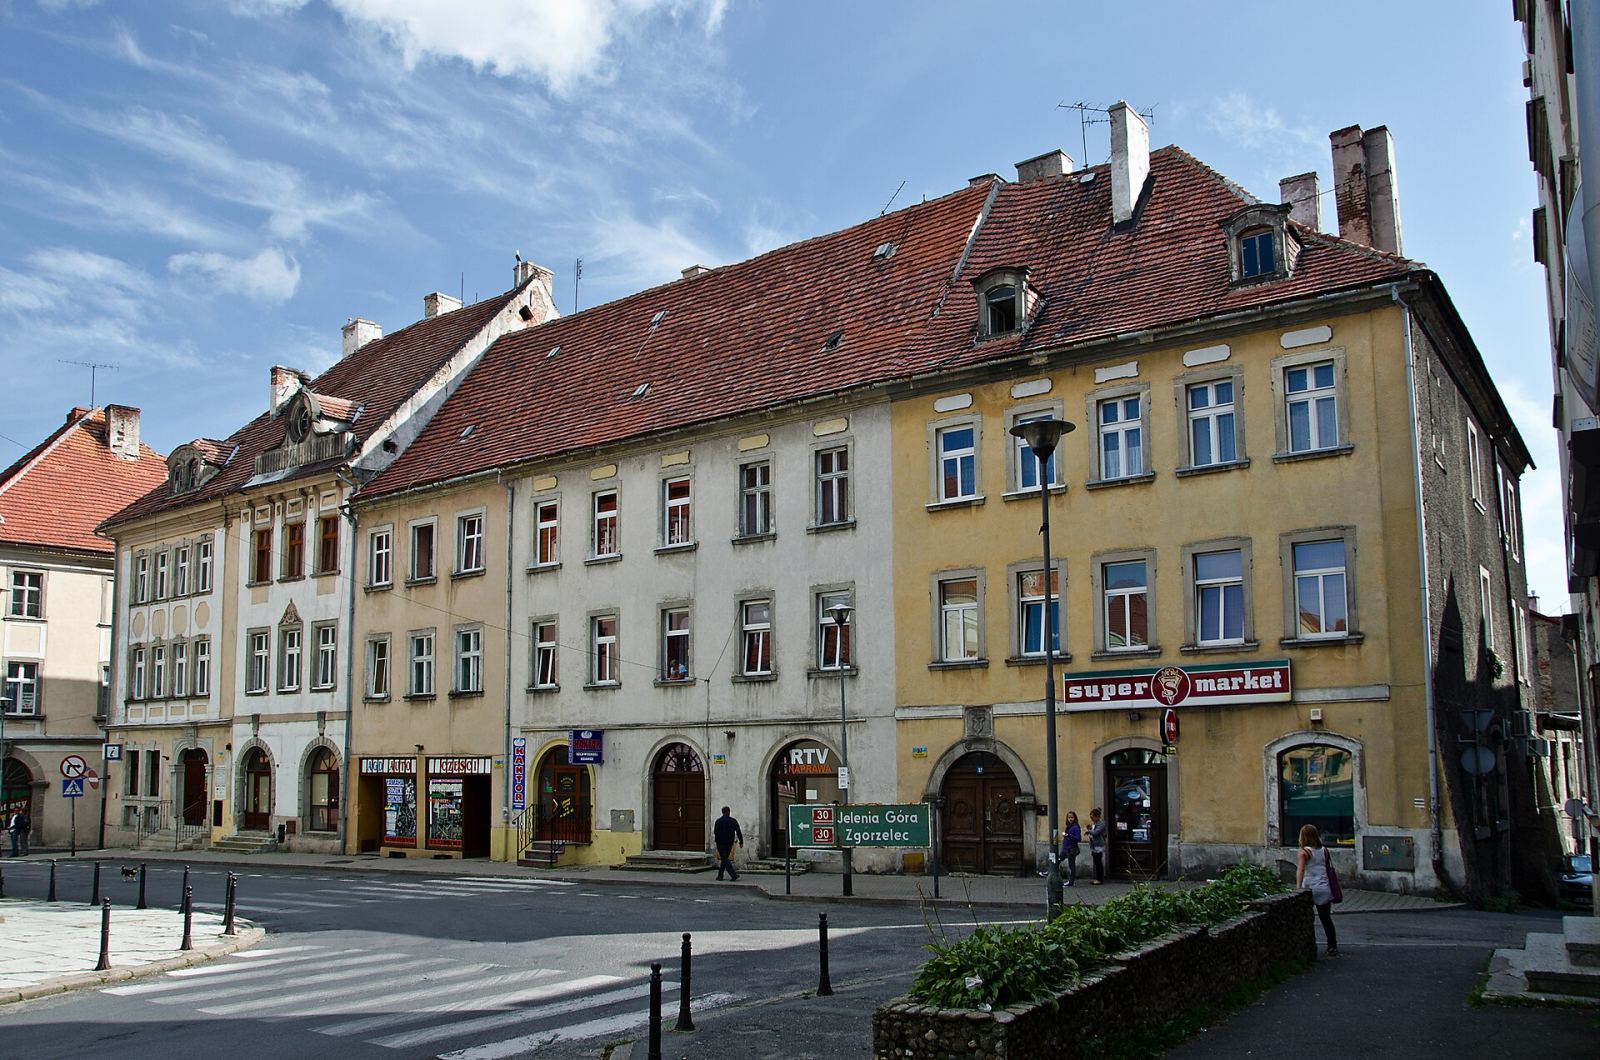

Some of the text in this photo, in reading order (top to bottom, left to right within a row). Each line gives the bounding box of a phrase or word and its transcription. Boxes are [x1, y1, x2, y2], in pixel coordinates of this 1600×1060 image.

[1068, 671, 1282, 701] super market
[790, 748, 829, 765] RTV
[514, 747, 525, 802] KANTOR
[788, 764, 832, 775] NAPRAWA
[817, 810, 918, 824] 30 Jelenia Góra
[817, 829, 909, 844] 30 Zgorzelec
